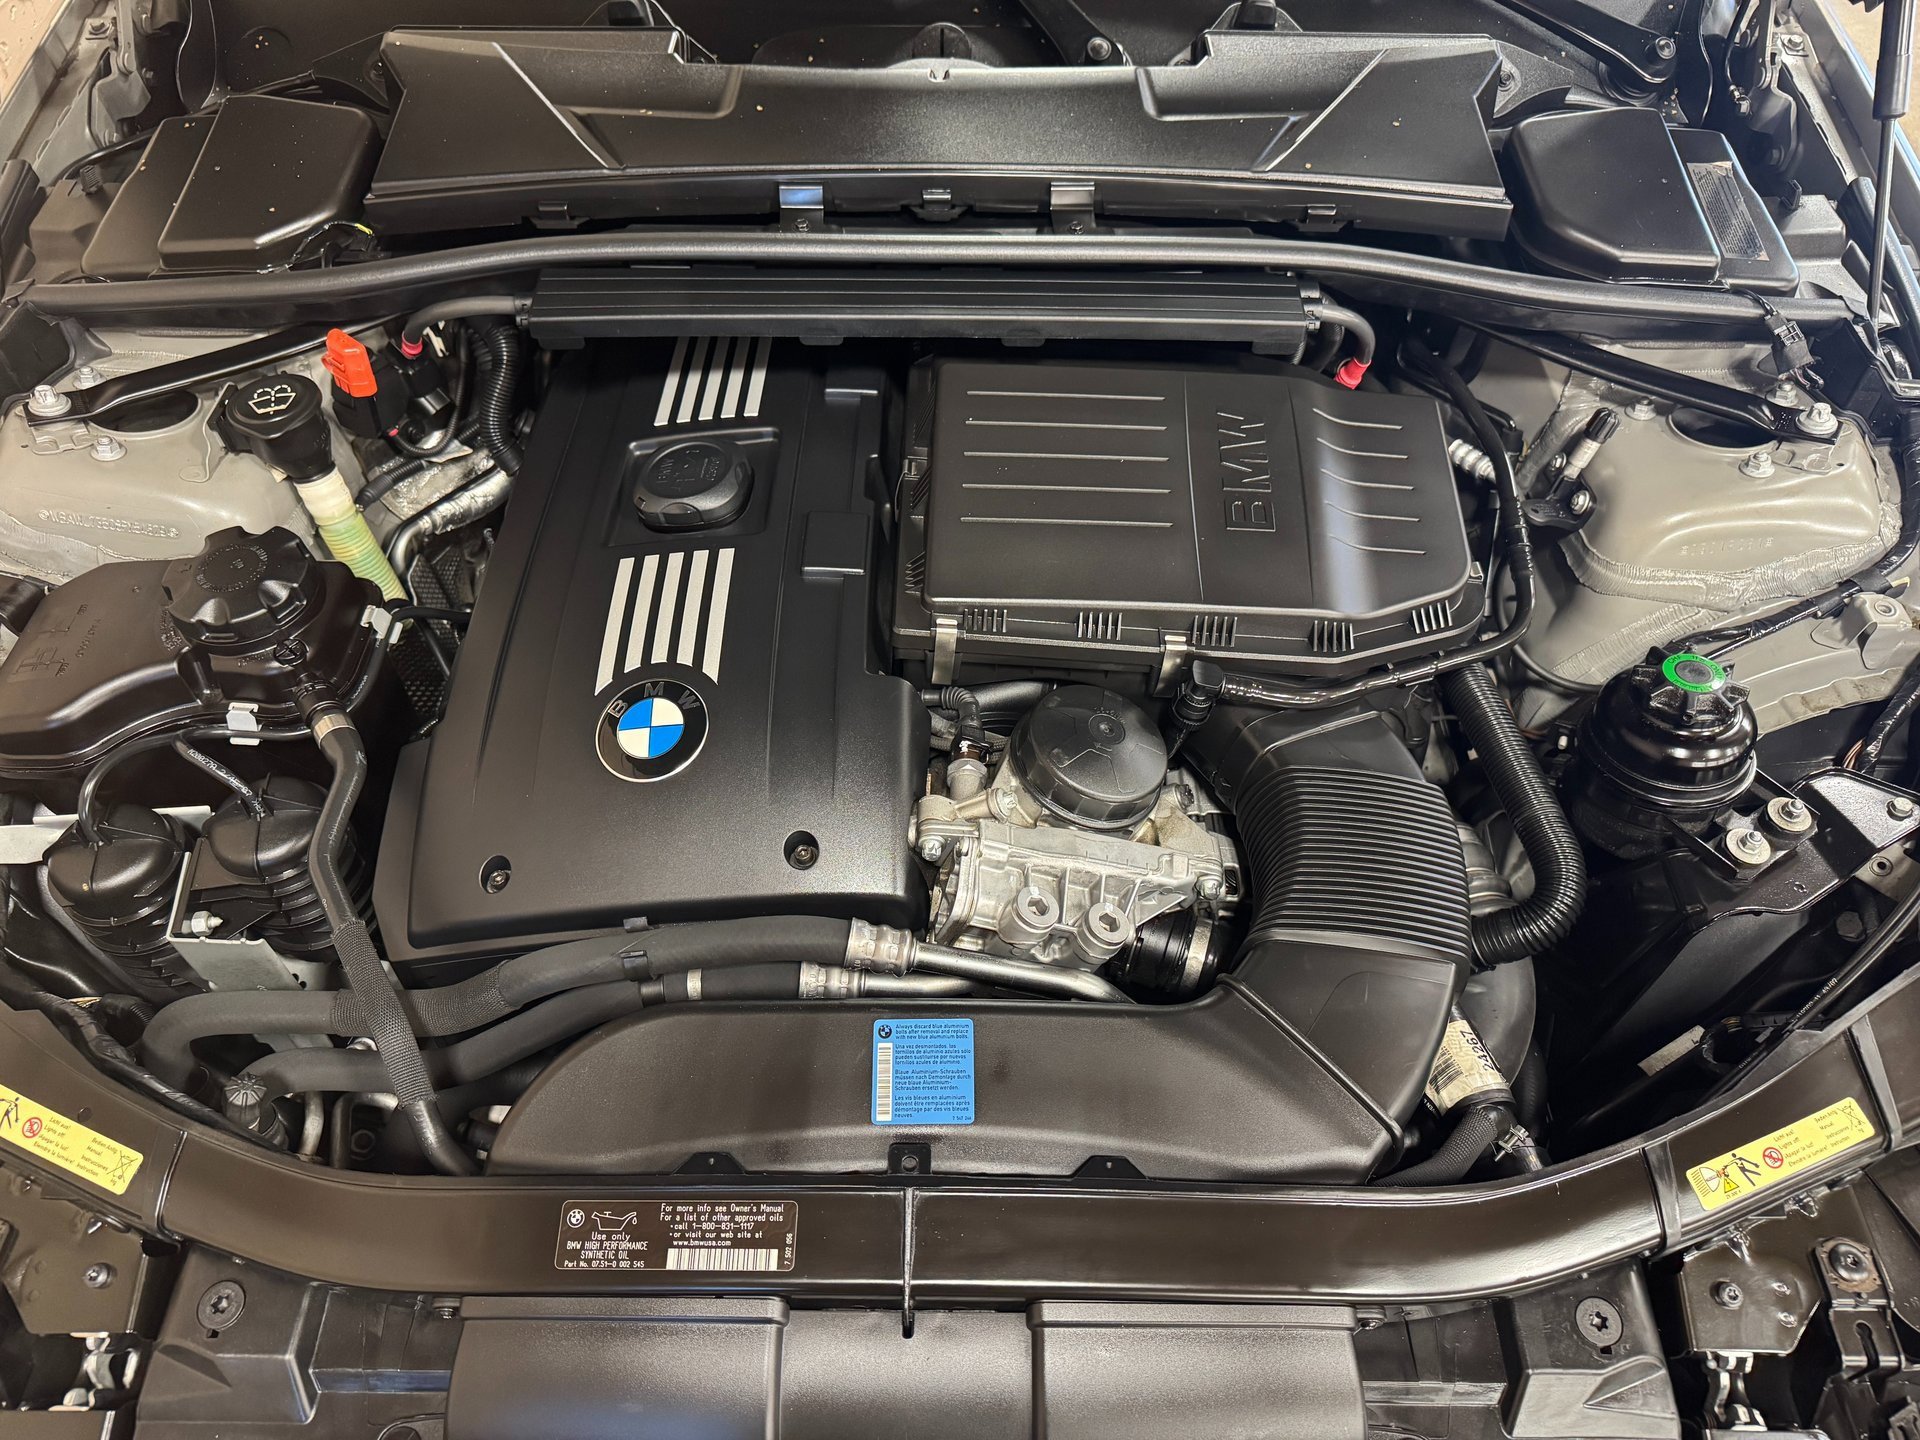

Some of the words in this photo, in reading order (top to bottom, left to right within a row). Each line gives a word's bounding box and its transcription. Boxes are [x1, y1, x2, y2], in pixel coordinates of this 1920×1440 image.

[1217, 412, 1276, 532] BMW
[608, 682, 700, 718] BMW
[1460, 1028, 1495, 1072] 24267
[661, 1203, 672, 1212] For
[697, 1204, 711, 1212] info
[731, 1204, 757, 1212] Owner's
[760, 1204, 784, 1212] Manual
[660, 1213, 672, 1221] For
[684, 1213, 697, 1221] list
[701, 1213, 709, 1221] of
[712, 1213, 731, 1221] other
[735, 1213, 766, 1223] approved
[769, 1213, 783, 1222] oils
[692, 1222, 754, 1230] 1-800-831-1117
[592, 1232, 606, 1240] Use
[612, 1232, 630, 1242] only
[567, 1241, 582, 1250] BMW
[585, 1241, 600, 1250] HIGH
[603, 1241, 648, 1250] PERFORMANCE
[581, 1250, 615, 1259] SYNTHETIC
[618, 1251, 629, 1259] OIL
